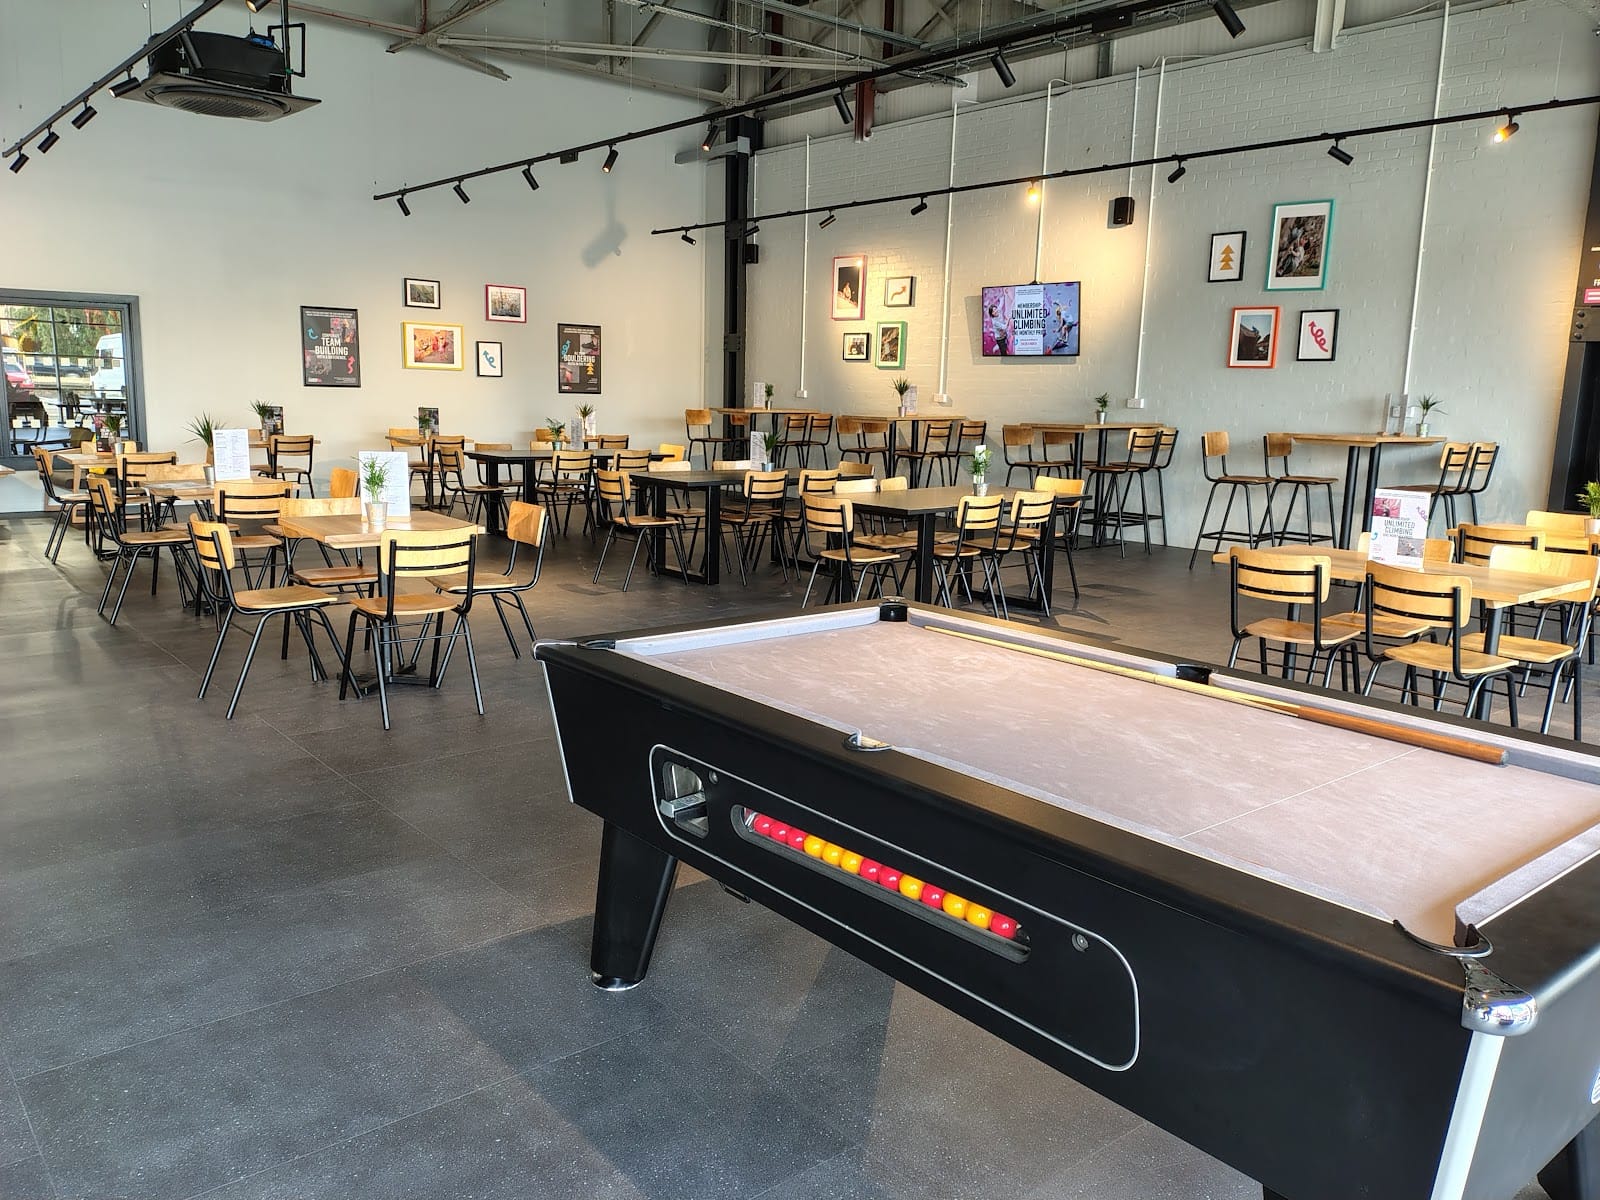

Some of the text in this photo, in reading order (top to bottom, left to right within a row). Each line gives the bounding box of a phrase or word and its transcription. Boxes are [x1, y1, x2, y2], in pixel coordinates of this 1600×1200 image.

[1012, 309, 1047, 319] UNLIMITED
[1013, 319, 1046, 330] CLIMBING
[321, 338, 341, 347] TEAM
[315, 346, 348, 356] BUILDING
[564, 355, 595, 363] BOULDERING
[1384, 520, 1415, 529] UNLIMITED
[1385, 527, 1413, 535] CLIMBING
